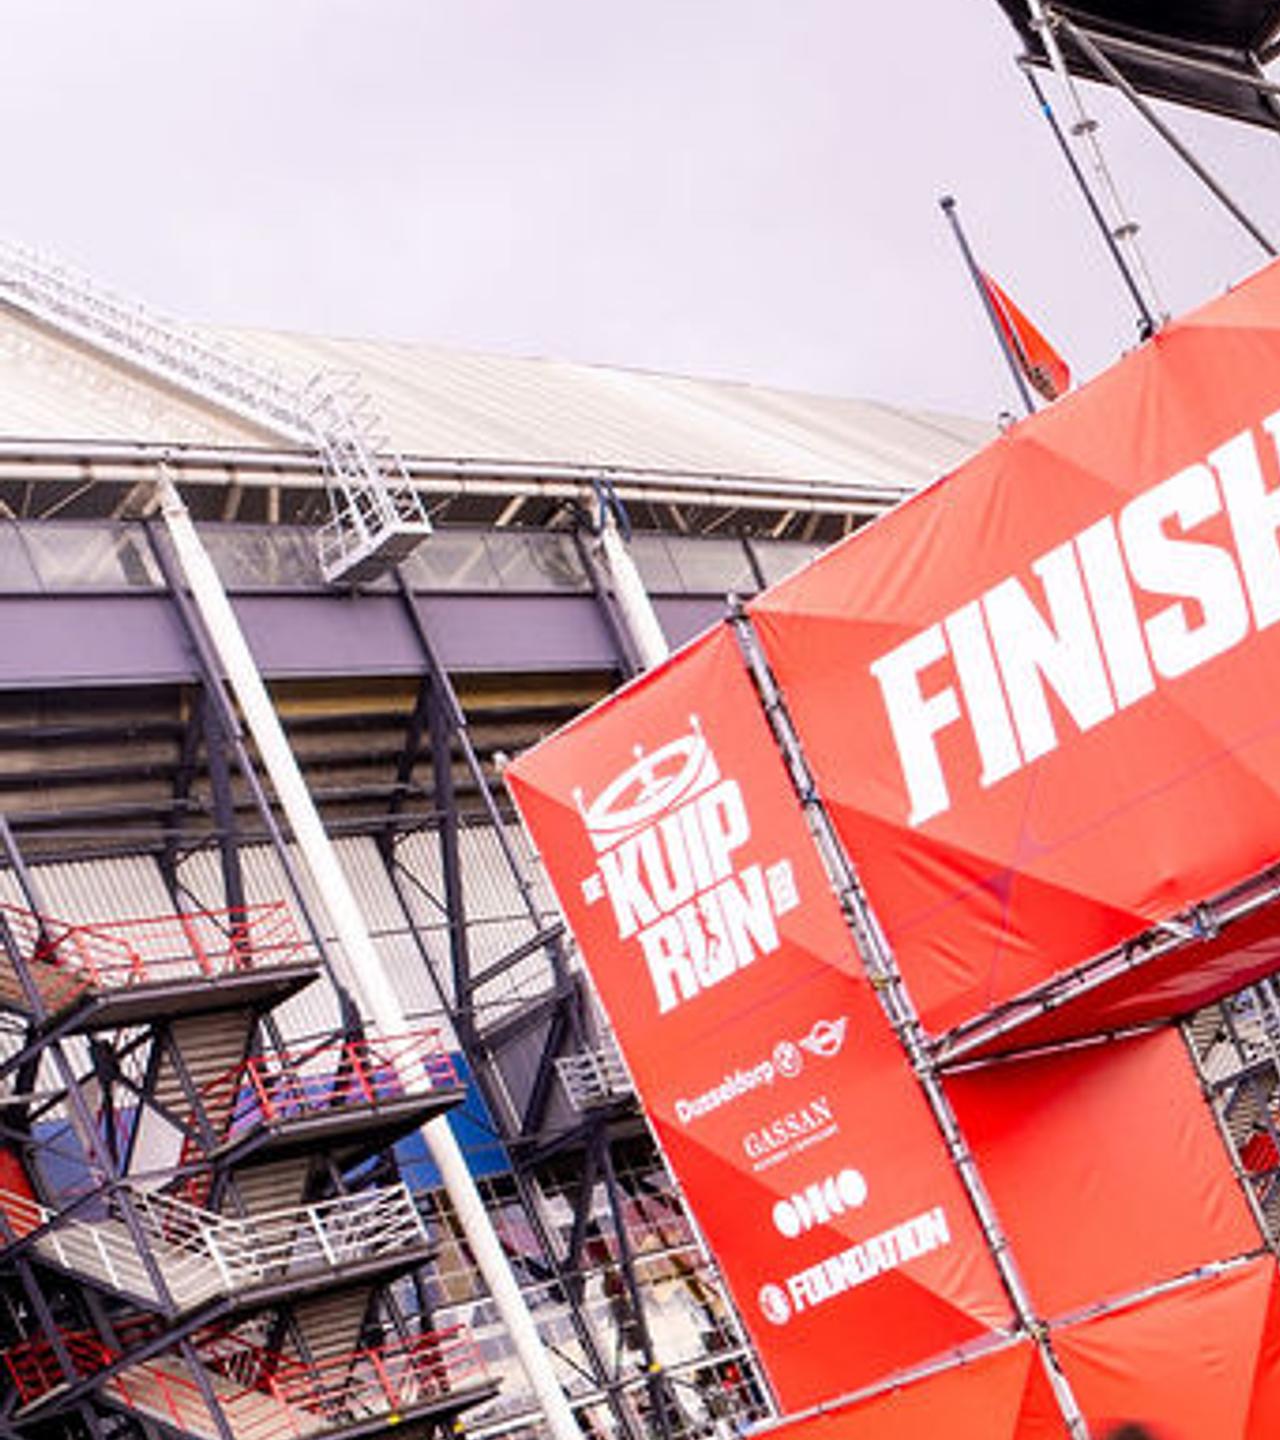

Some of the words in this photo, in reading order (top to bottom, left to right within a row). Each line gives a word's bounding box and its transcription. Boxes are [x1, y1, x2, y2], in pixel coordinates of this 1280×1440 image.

[597, 778, 751, 942] KUIP
[637, 863, 781, 1014] RUN
[743, 1096, 834, 1158] GASSAN
[785, 1206, 951, 1313] FOUNDATION
